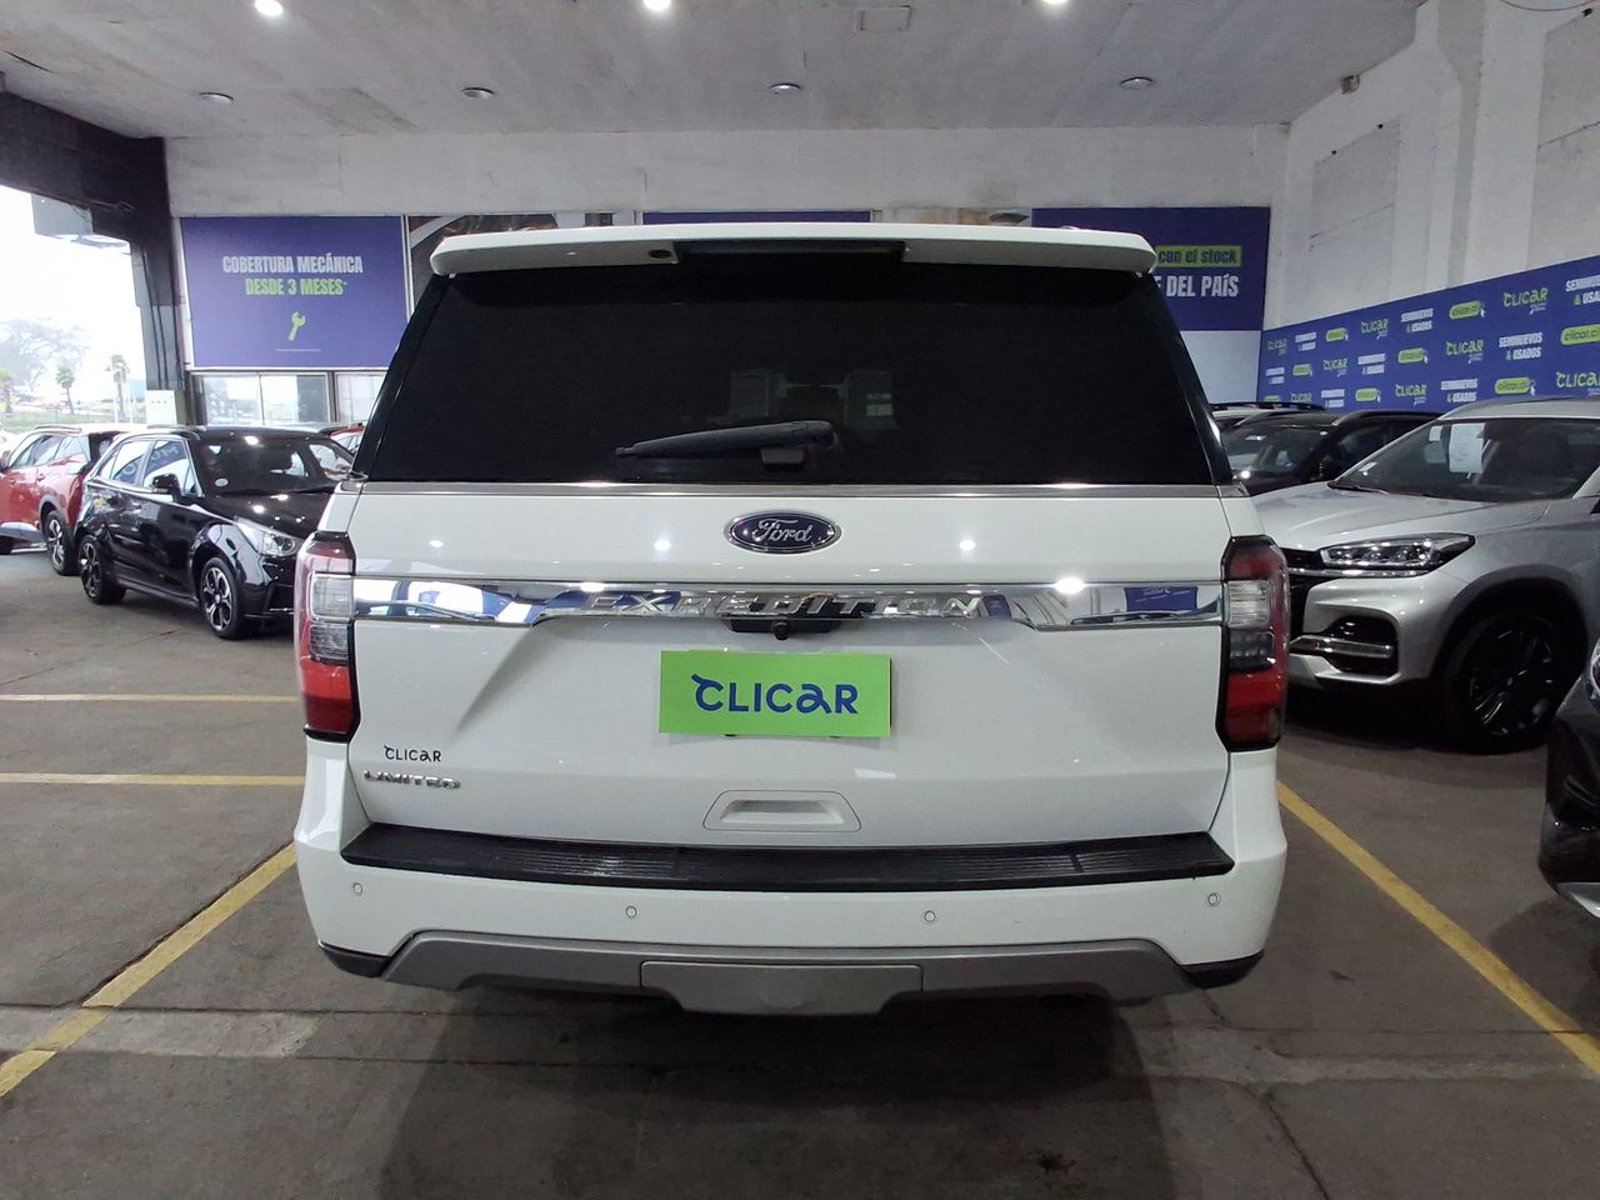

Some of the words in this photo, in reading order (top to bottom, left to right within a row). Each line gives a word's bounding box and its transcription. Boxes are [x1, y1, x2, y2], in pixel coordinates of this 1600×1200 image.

[222, 256, 294, 273] COBERTURA
[297, 252, 364, 273] MECÁNICA
[1159, 251, 1181, 263] con
[1186, 249, 1197, 263] el
[1201, 249, 1237, 263] stock
[245, 279, 285, 295] DESDE
[288, 279, 296, 295] 3
[1166, 276, 1196, 297] DEL
[1201, 274, 1239, 297] PAÍS
[752, 519, 814, 541] Ford
[590, 594, 984, 617] EXPEDITION
